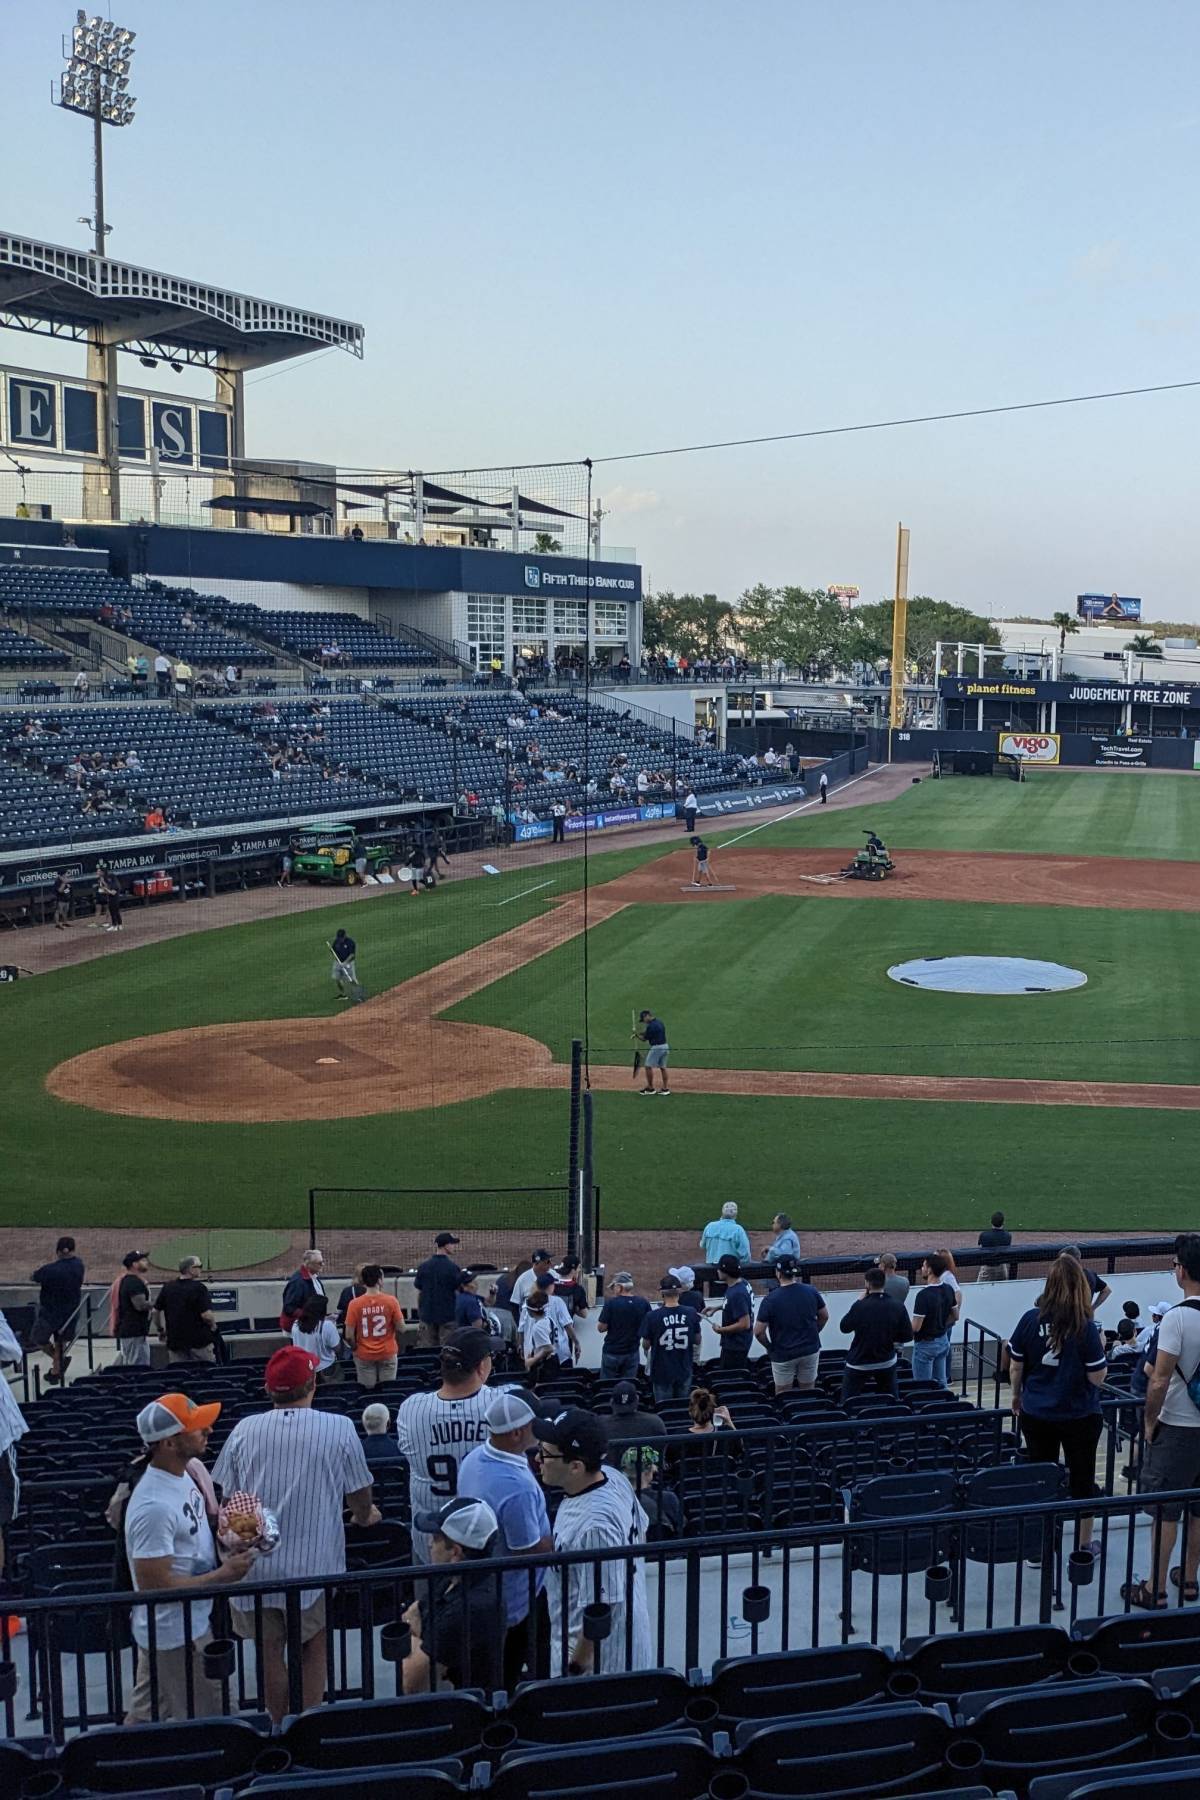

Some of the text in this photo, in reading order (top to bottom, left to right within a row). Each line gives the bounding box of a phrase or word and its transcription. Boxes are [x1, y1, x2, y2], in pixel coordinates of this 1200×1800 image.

[15, 384, 52, 442] E
[160, 409, 186, 459] S
[966, 683, 1036, 695] planet fitness
[1069, 687, 1190, 704] JUDGEMENT FREE ZONE
[898, 732, 910, 741] 318
[241, 838, 281, 852] TAMPA BAY
[108, 854, 156, 870] TAMPA BAY
[361, 1315, 387, 1338] 12
[663, 1314, 687, 1327] COLE
[659, 1326, 689, 1351] 45
[430, 1420, 491, 1447] JUDGE
